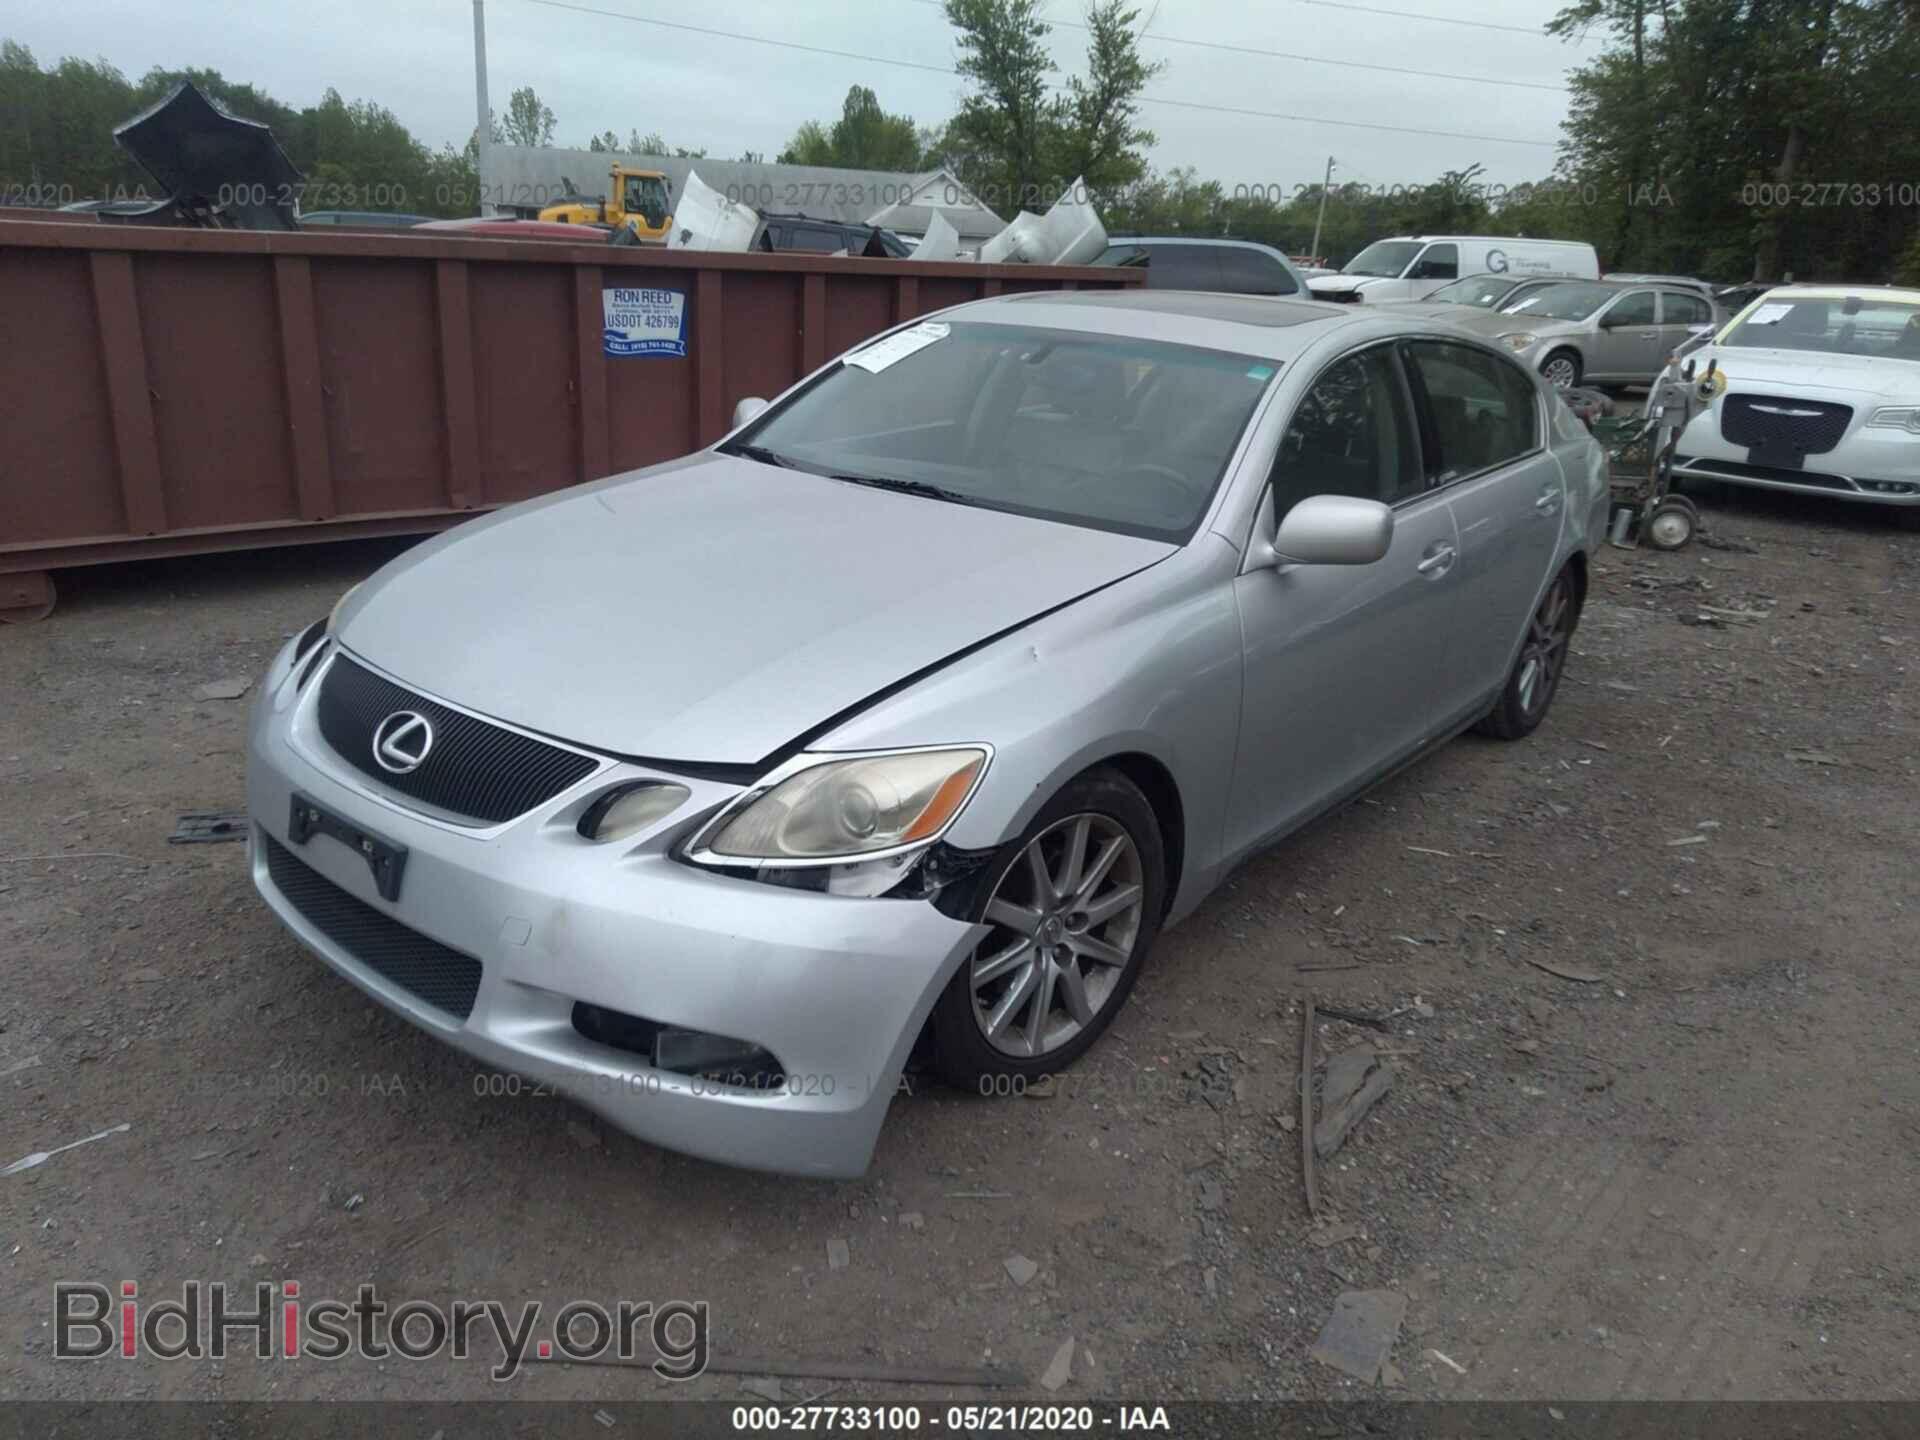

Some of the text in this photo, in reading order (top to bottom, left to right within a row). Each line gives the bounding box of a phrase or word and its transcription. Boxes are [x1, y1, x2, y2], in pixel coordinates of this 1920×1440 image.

[614, 290, 639, 303] RON
[608, 315, 679, 329] USDOT 426799
